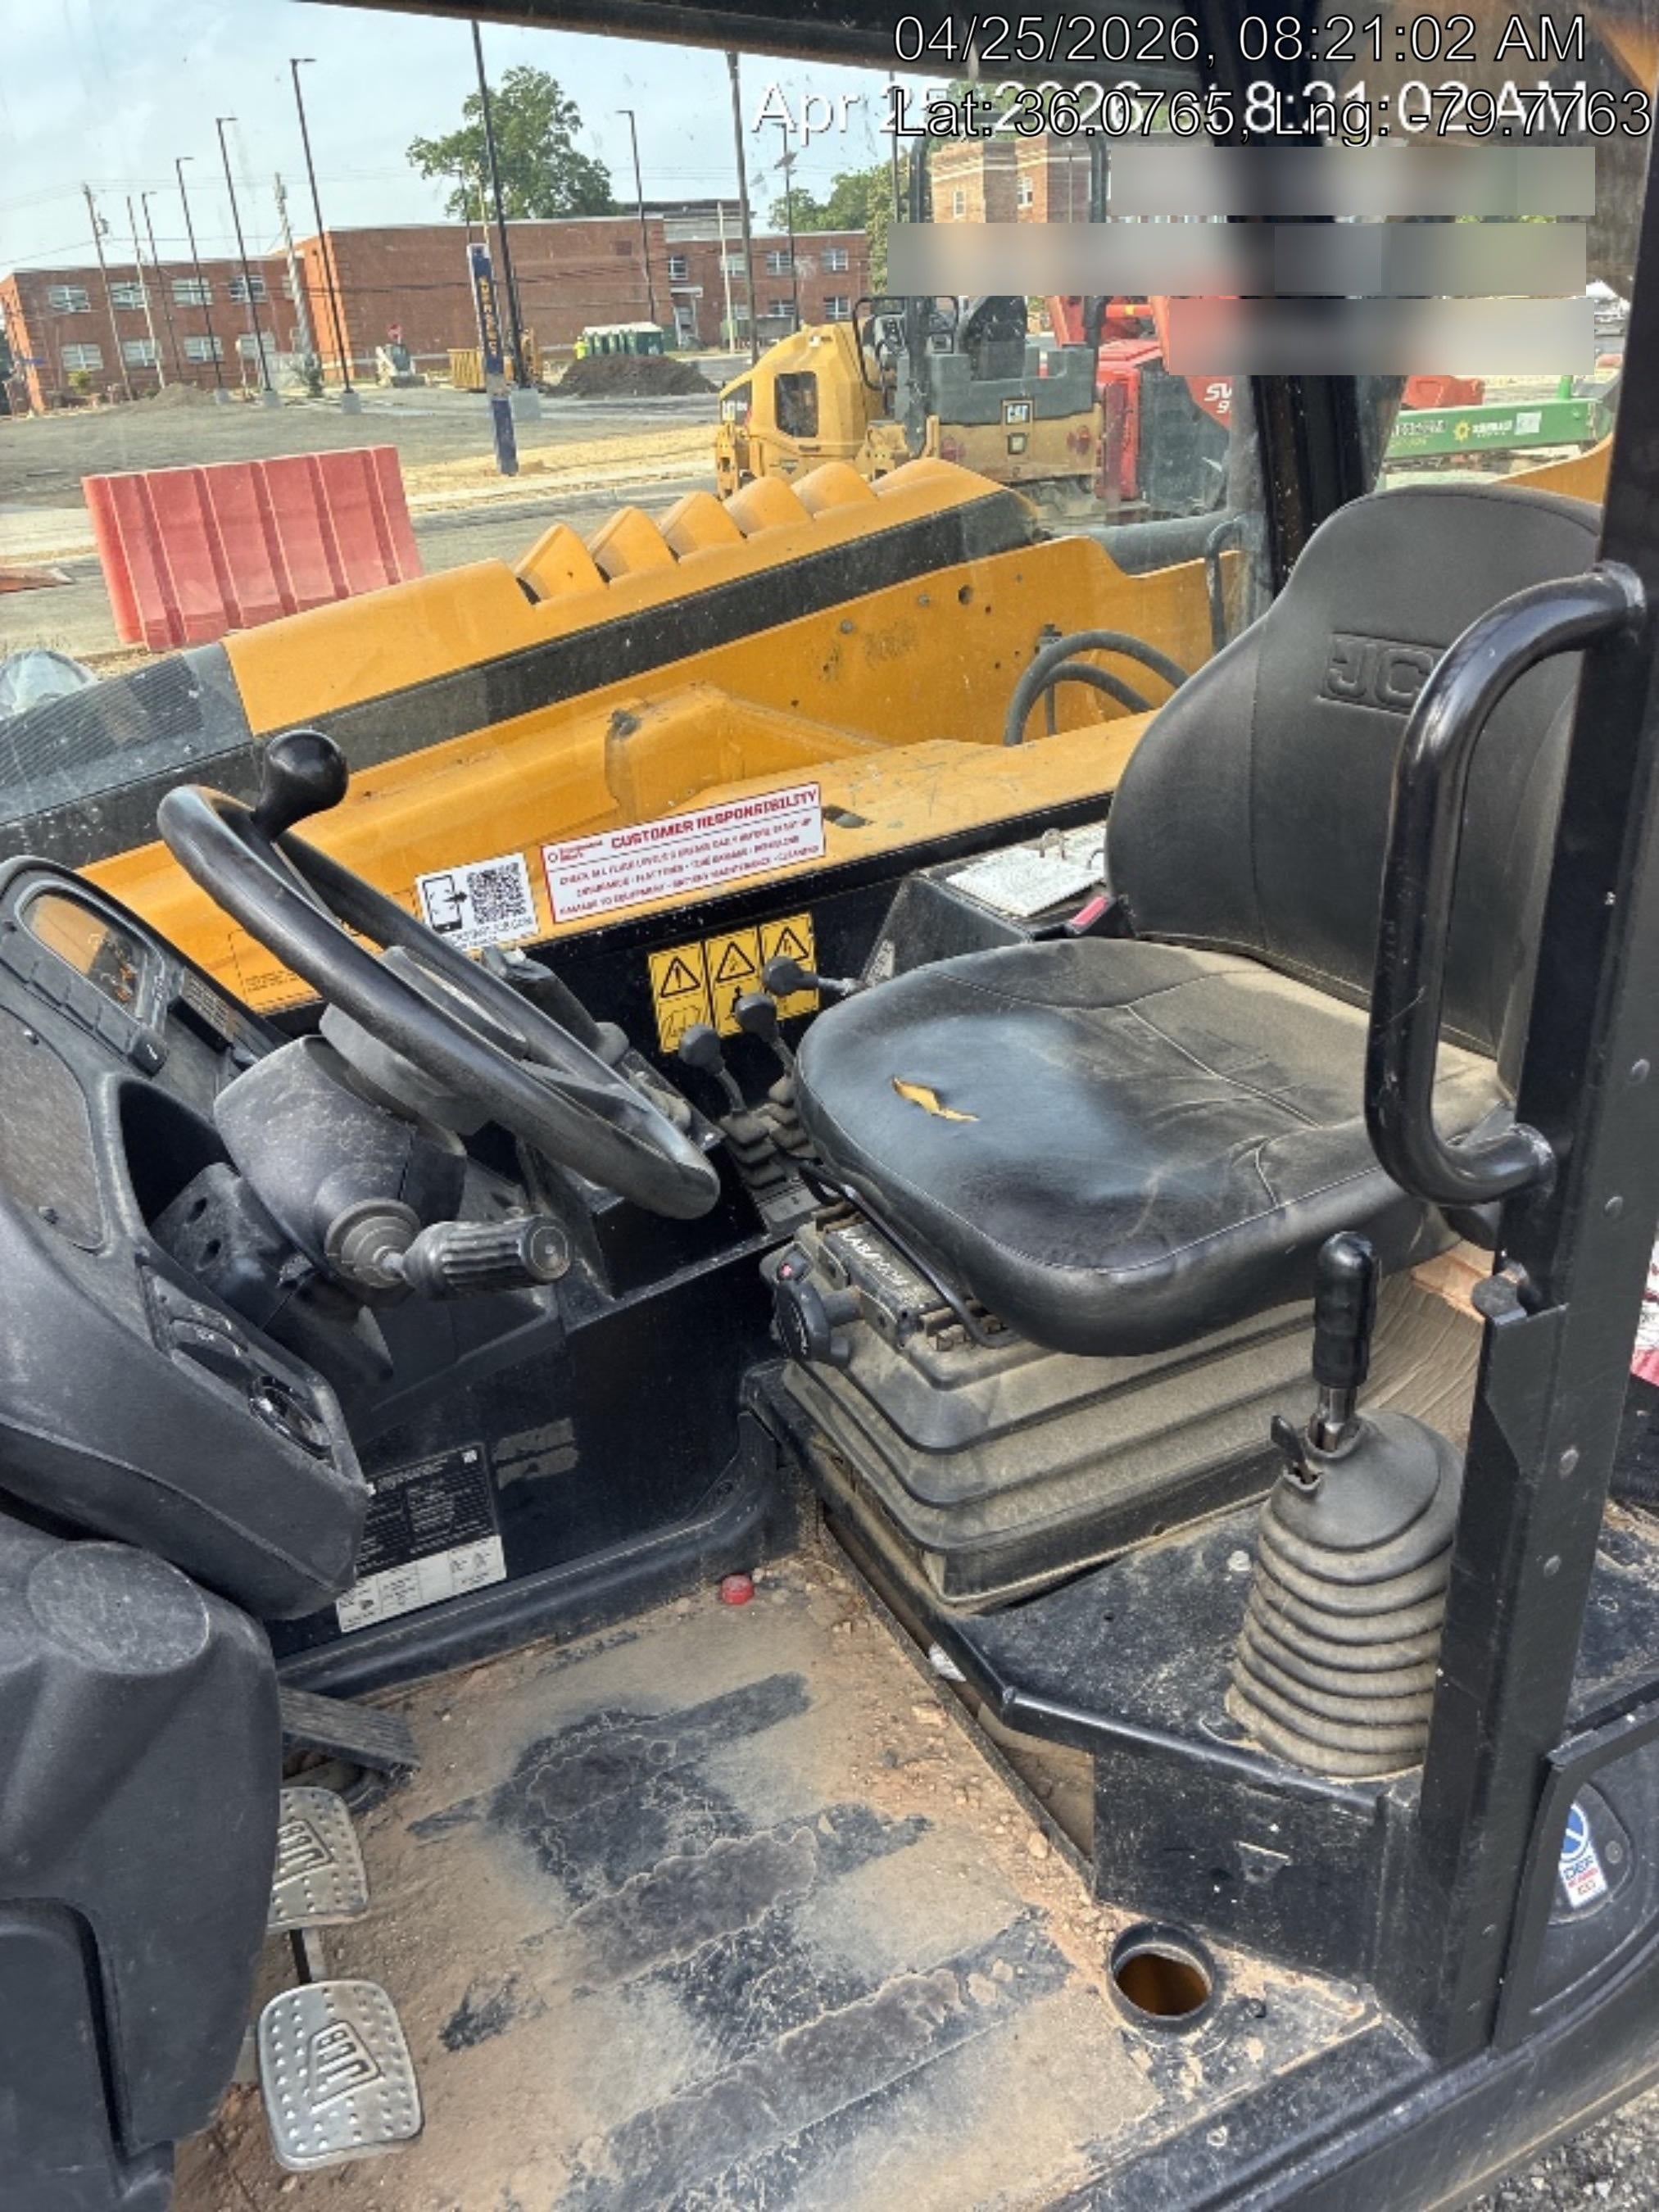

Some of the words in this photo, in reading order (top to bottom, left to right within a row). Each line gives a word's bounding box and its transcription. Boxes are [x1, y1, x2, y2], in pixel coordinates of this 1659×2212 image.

[1216, 400, 1232, 414] 9
[1326, 636, 1435, 708] JC
[611, 818, 694, 848] CUSTOMER
[696, 788, 818, 829] RESPONSIBILITY
